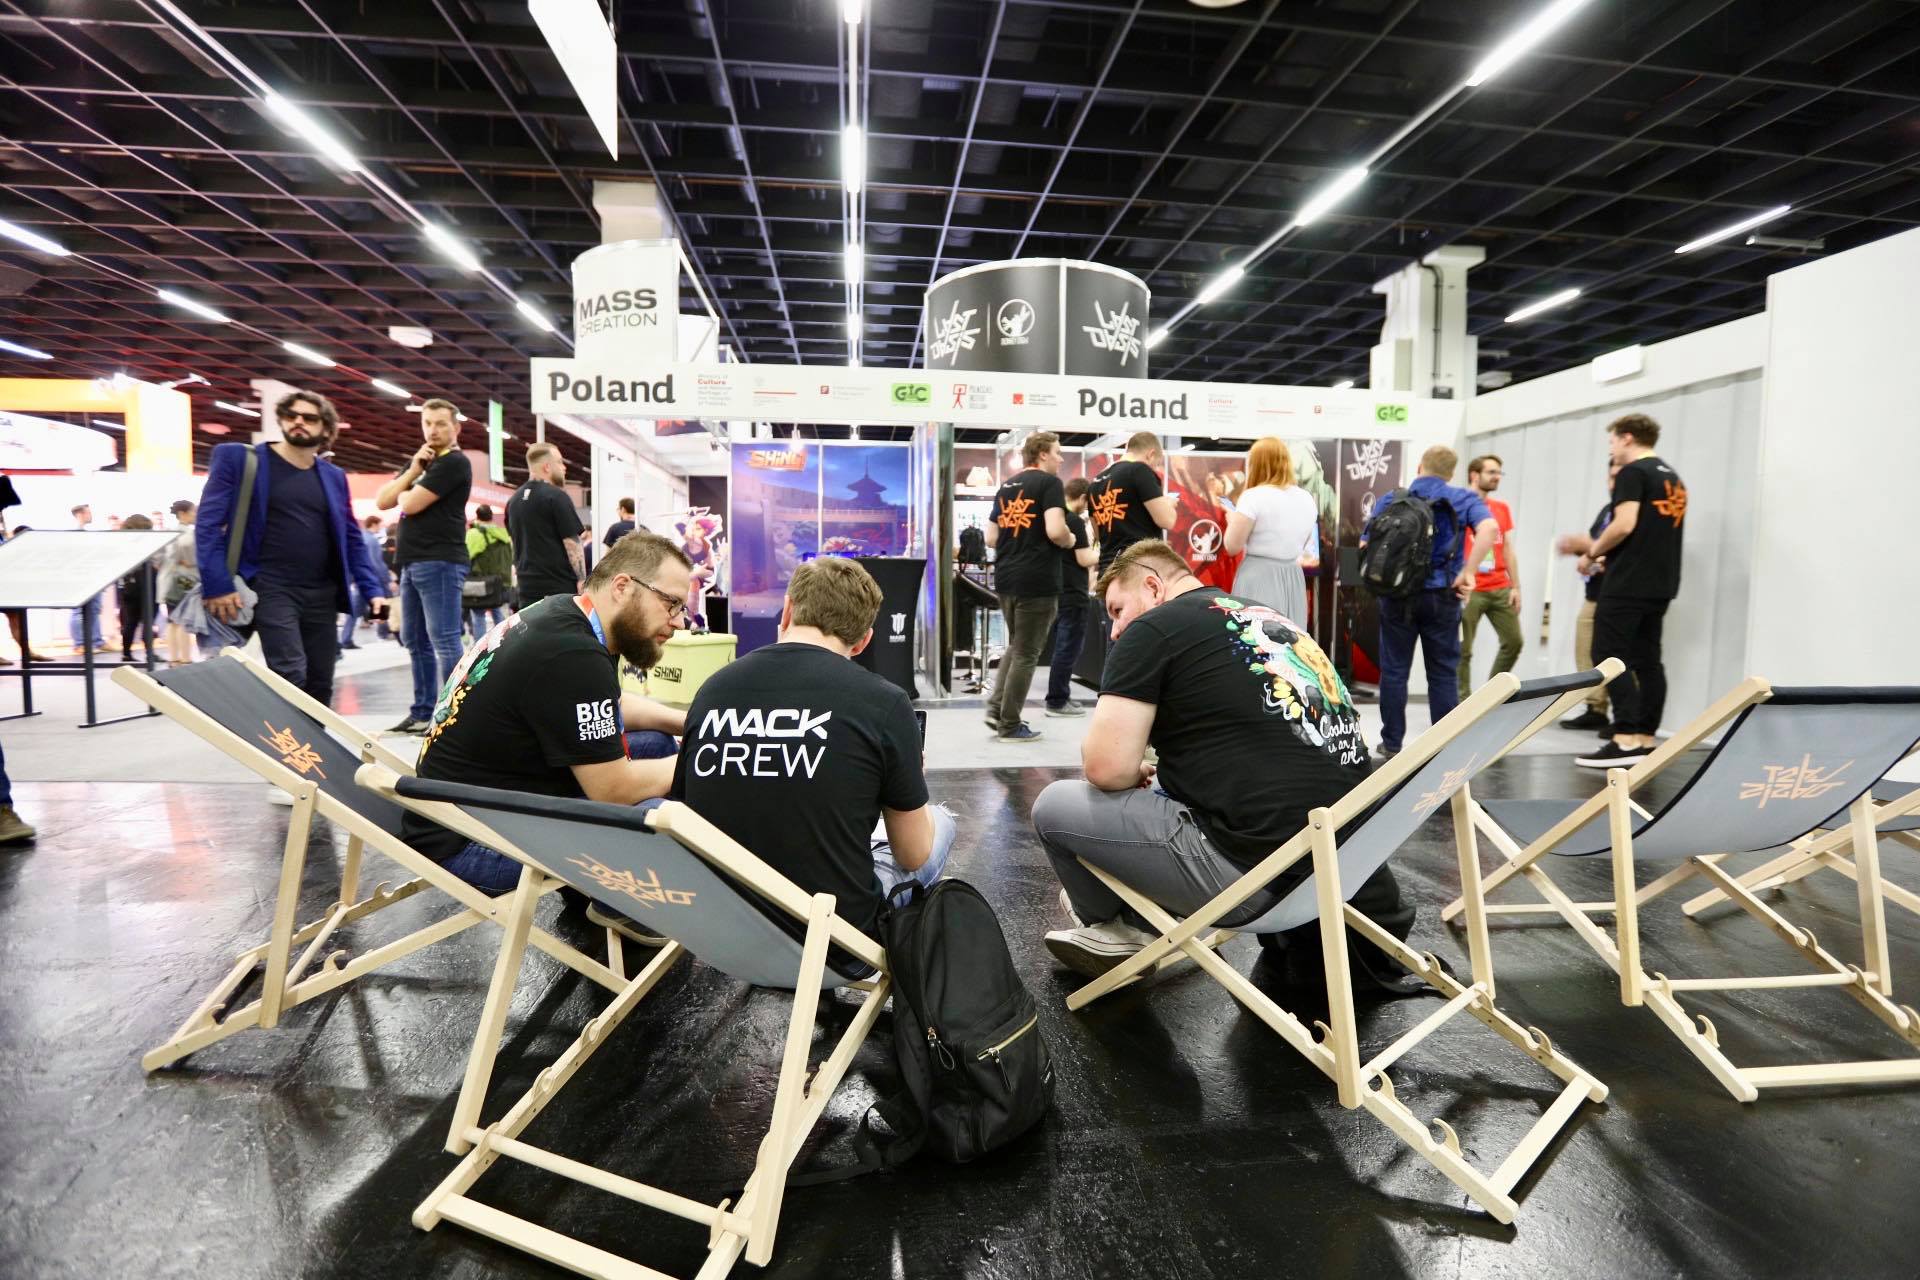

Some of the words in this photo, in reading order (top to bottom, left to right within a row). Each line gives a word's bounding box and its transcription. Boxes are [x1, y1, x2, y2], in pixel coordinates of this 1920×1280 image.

[579, 288, 657, 321] MASS
[548, 371, 676, 404] Poland
[1077, 388, 1189, 420] Poland
[576, 698, 614, 723] BIG
[578, 716, 615, 732] CHEESE
[699, 708, 832, 739] MACK
[579, 725, 616, 741] STUDIO
[1320, 714, 1360, 741] Cooking
[695, 742, 826, 778] CREW
[1328, 741, 1337, 754] is
